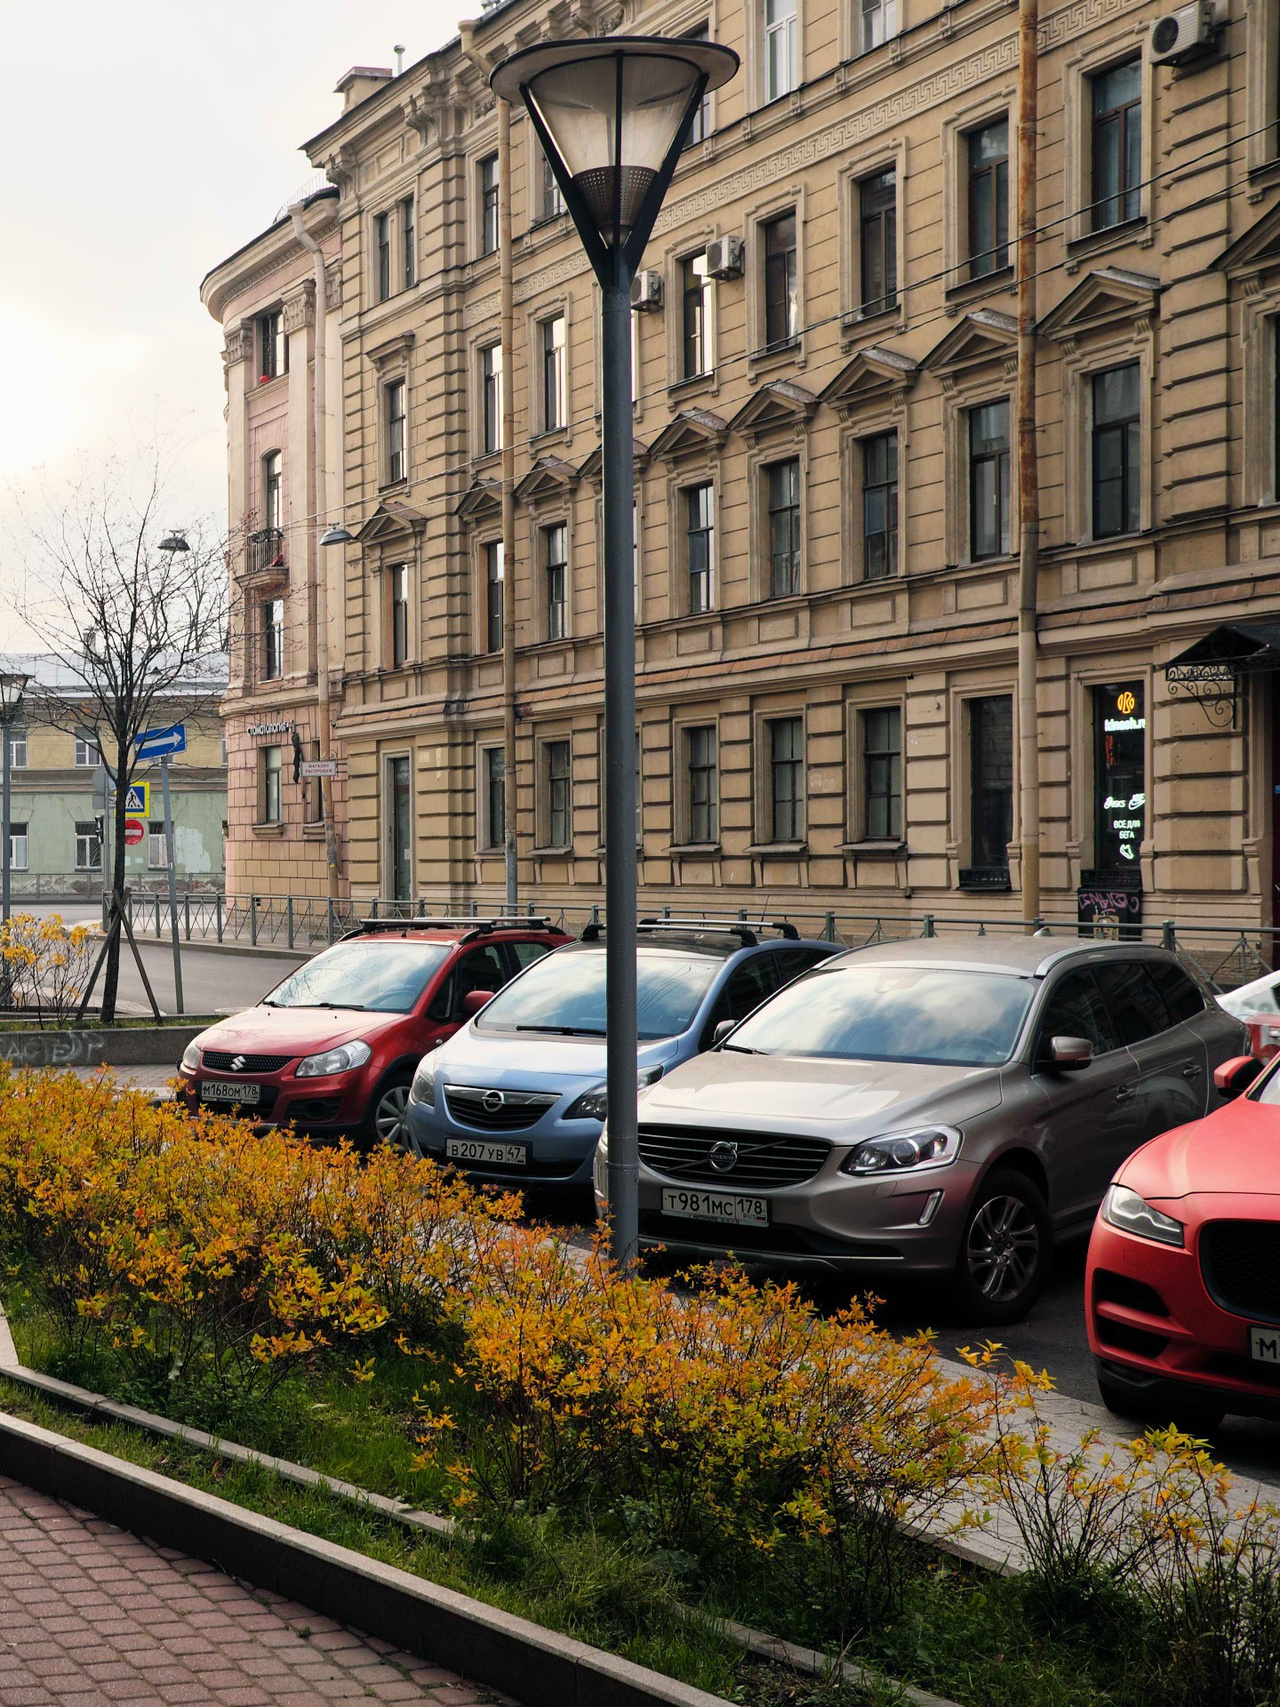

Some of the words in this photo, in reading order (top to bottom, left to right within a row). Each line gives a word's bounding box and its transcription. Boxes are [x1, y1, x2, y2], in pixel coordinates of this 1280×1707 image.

[1114, 820, 1127, 829] ВСЕ
[507, 1147, 521, 1158] 47
[737, 1199, 762, 1214] 178
